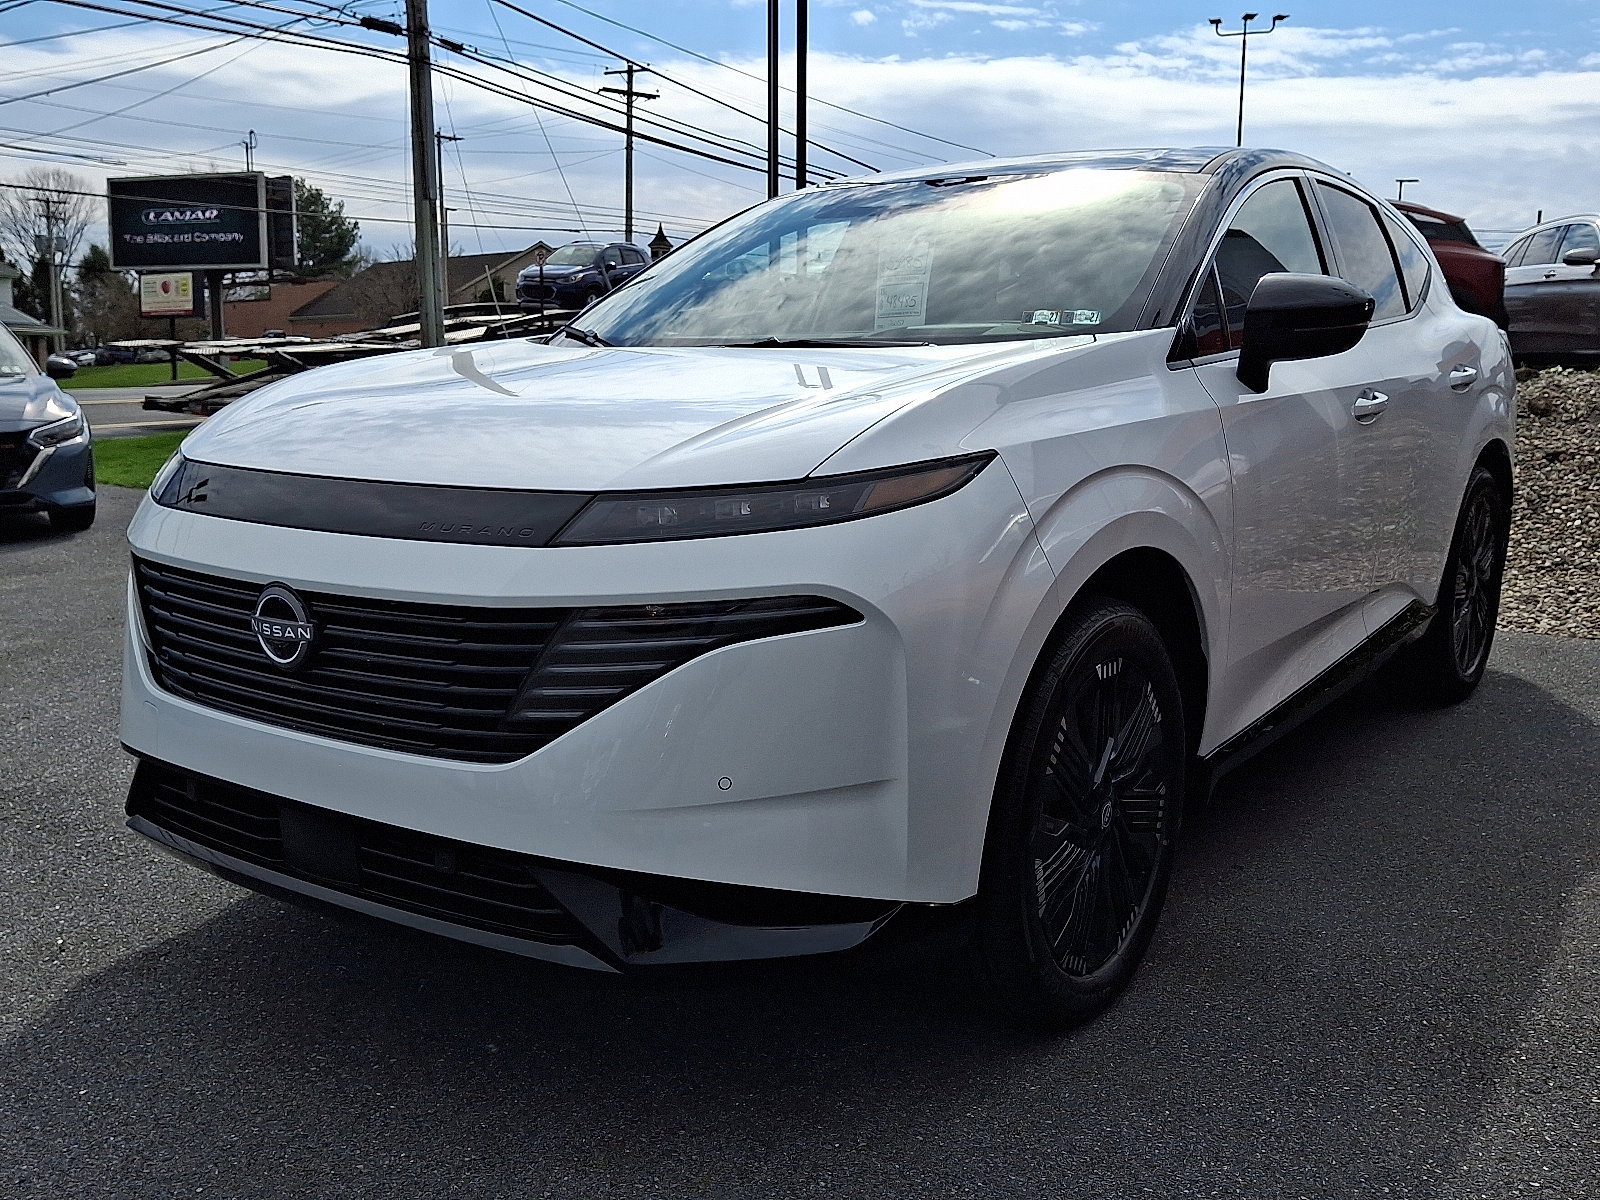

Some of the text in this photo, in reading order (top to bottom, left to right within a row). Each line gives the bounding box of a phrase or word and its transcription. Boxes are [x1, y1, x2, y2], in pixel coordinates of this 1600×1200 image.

[148, 209, 218, 221] LAMAR
[420, 521, 535, 538] MURANO
[251, 618, 311, 639] NISSAN
